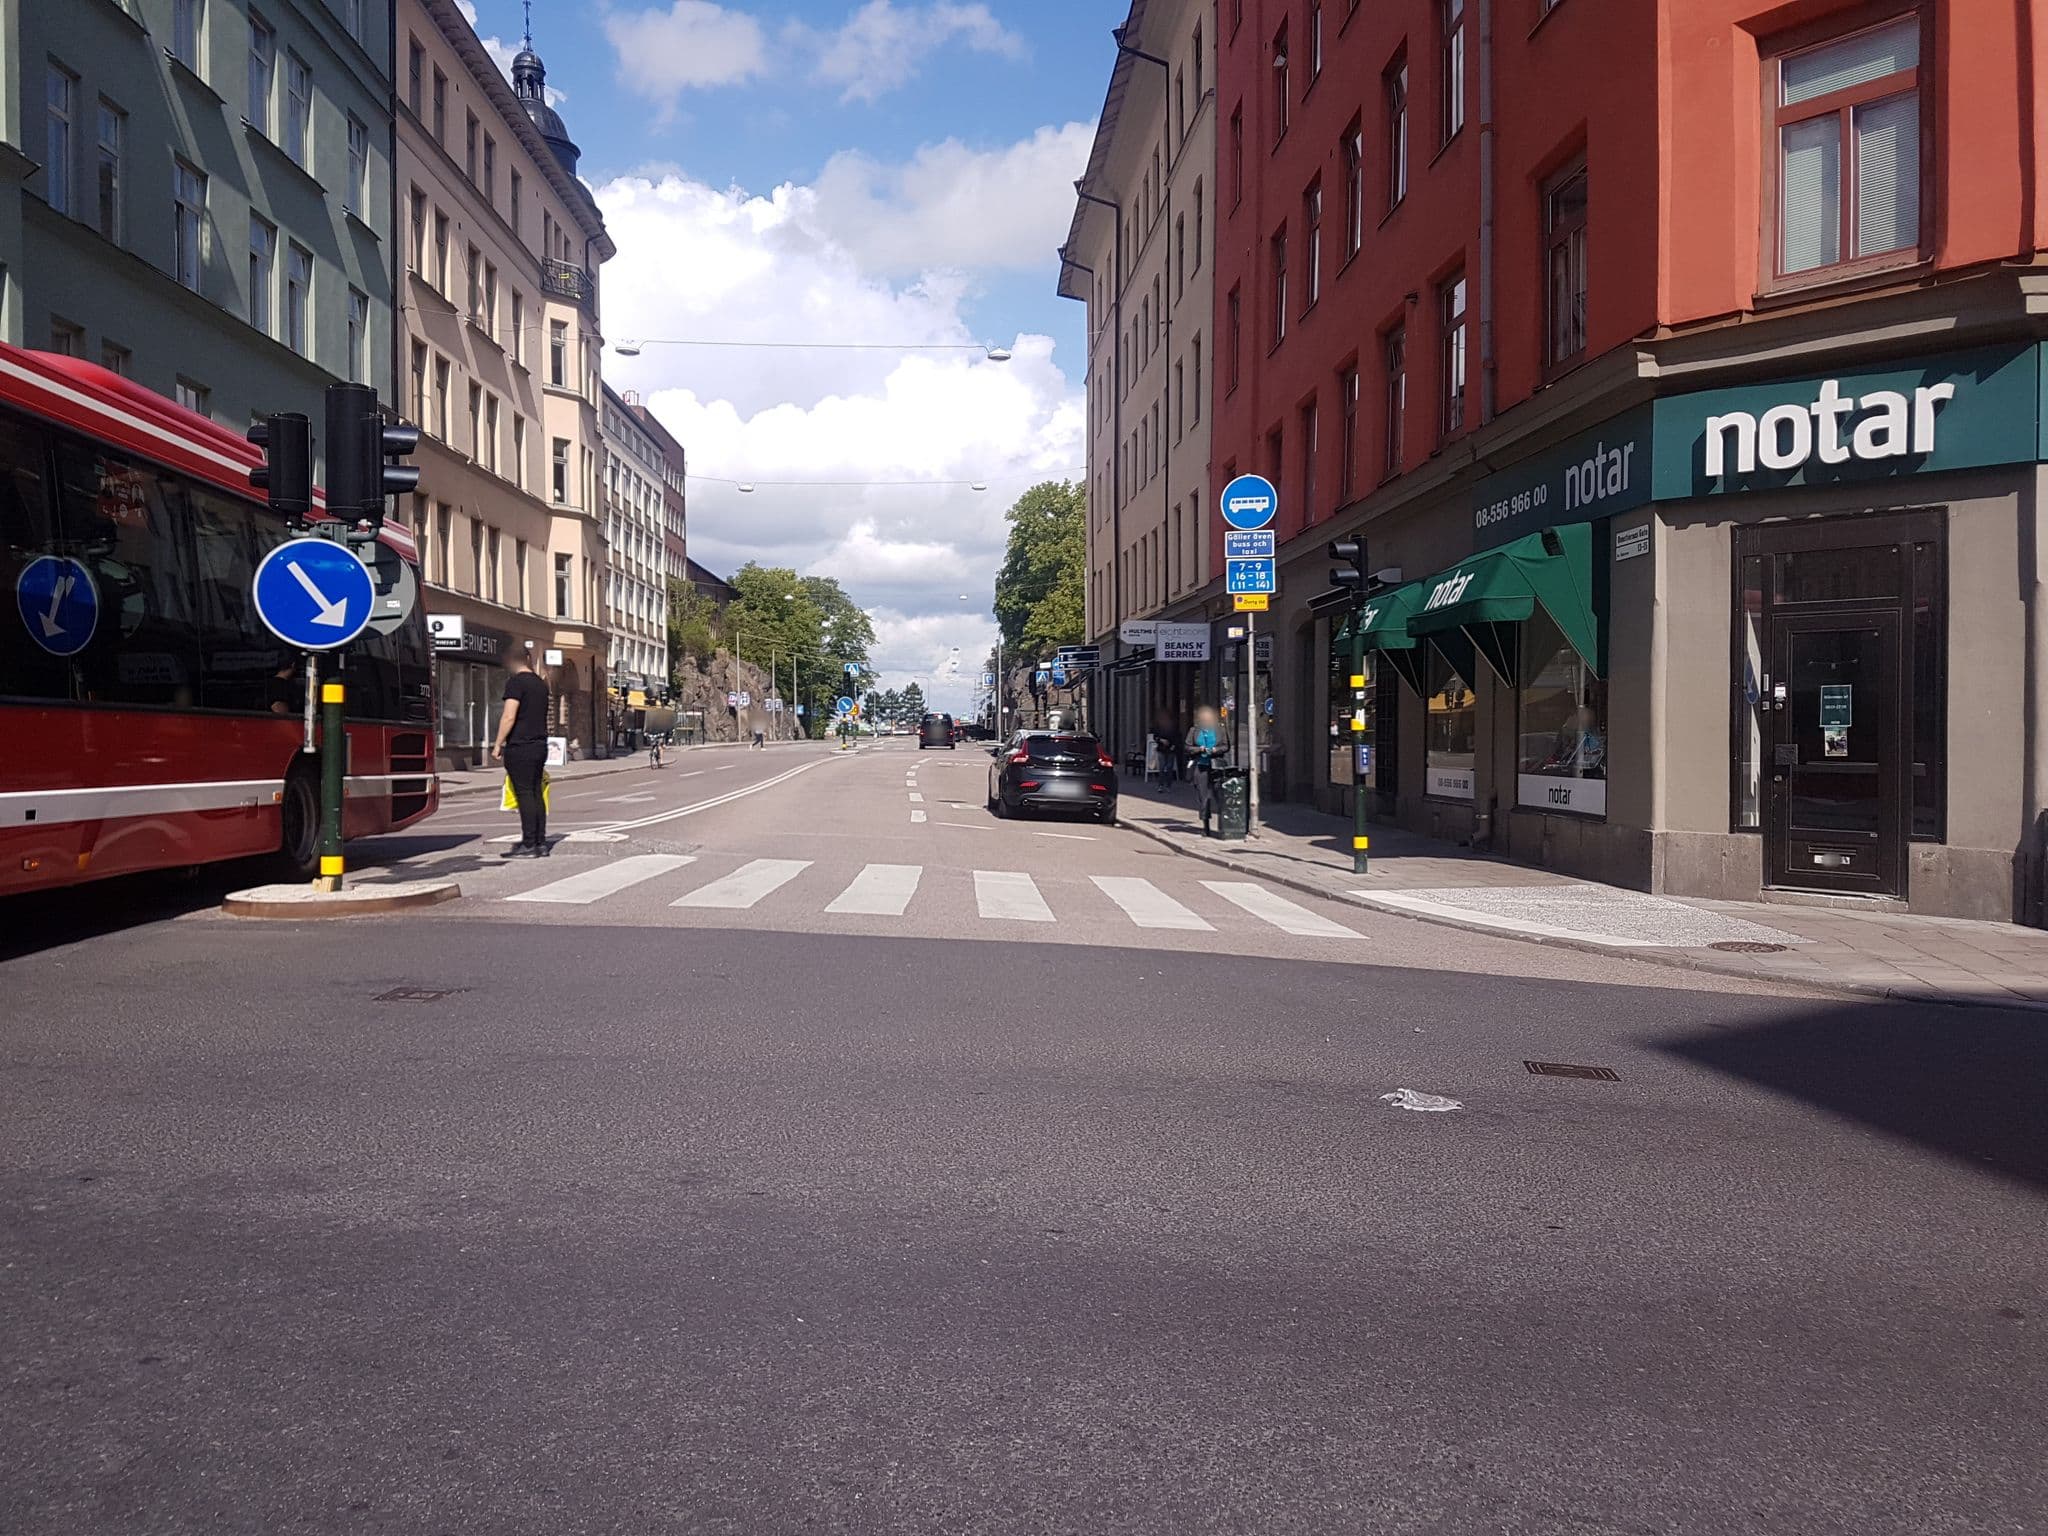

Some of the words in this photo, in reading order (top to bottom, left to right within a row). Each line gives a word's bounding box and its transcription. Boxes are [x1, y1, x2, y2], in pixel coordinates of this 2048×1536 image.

[1705, 379, 1955, 477] notar
[1565, 441, 1635, 511] notar
[1476, 499, 1509, 529] 08-556
[1511, 490, 1531, 516] 966
[1533, 484, 1548, 506] 00
[1227, 533, 1251, 541] Gäller
[1423, 569, 1475, 611] notar
[1164, 641, 1194, 650] BEANS
[1164, 650, 1203, 659] BERRIES
[1548, 785, 1572, 805] notar
